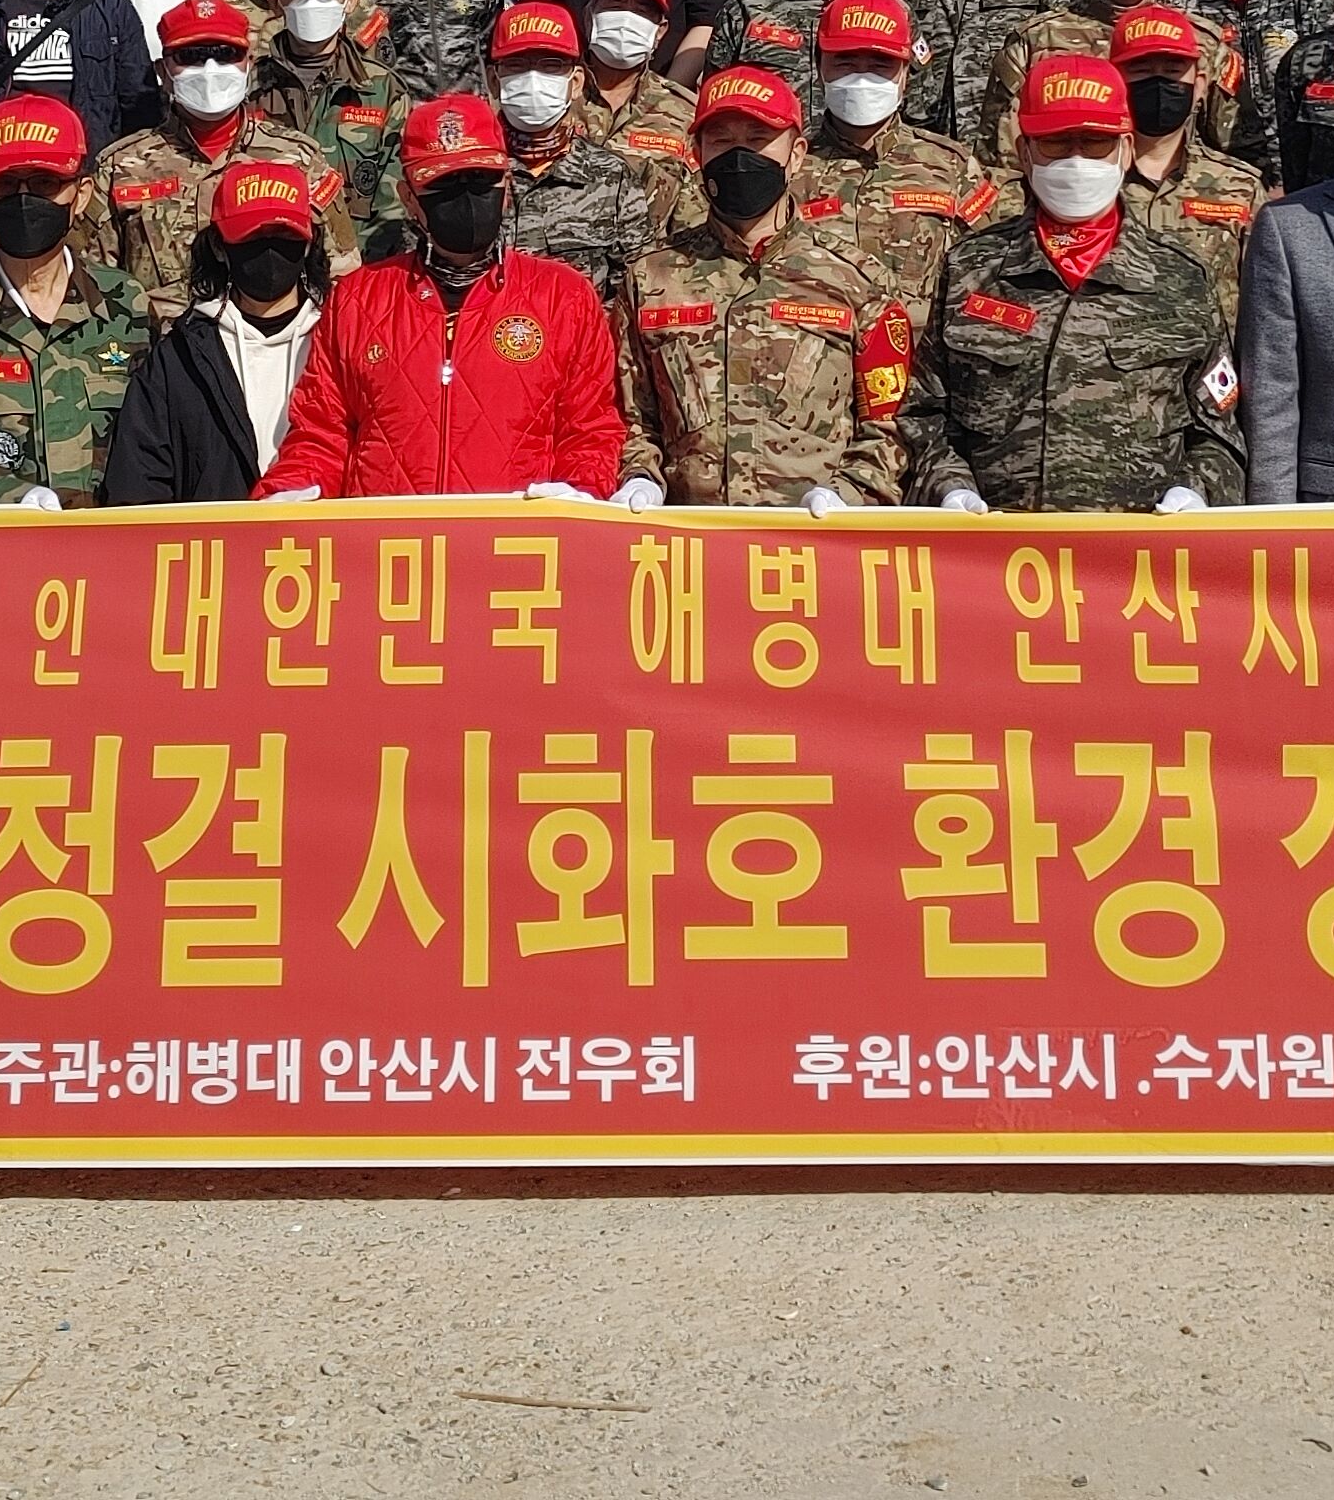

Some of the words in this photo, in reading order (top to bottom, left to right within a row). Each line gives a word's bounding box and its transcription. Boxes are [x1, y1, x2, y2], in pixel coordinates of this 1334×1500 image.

[509, 16, 563, 40] ROKMC
[841, 10, 898, 35] ROKMC
[1124, 21, 1183, 44] ROKMC
[707, 78, 775, 108] ROKMC
[1042, 79, 1113, 105] ROKMC
[235, 179, 299, 207] ROKMC
[150, 536, 562, 689] 대한민국
[629, 535, 937, 687] 해병대
[1005, 546, 1319, 687] 안산시
[336, 729, 848, 989] 시화호
[901, 729, 1227, 988] 환경
[319, 1036, 497, 1104] 안산시
[516, 1035, 697, 1103] 전우회
[792, 1033, 1118, 1101] 후원:안산시
